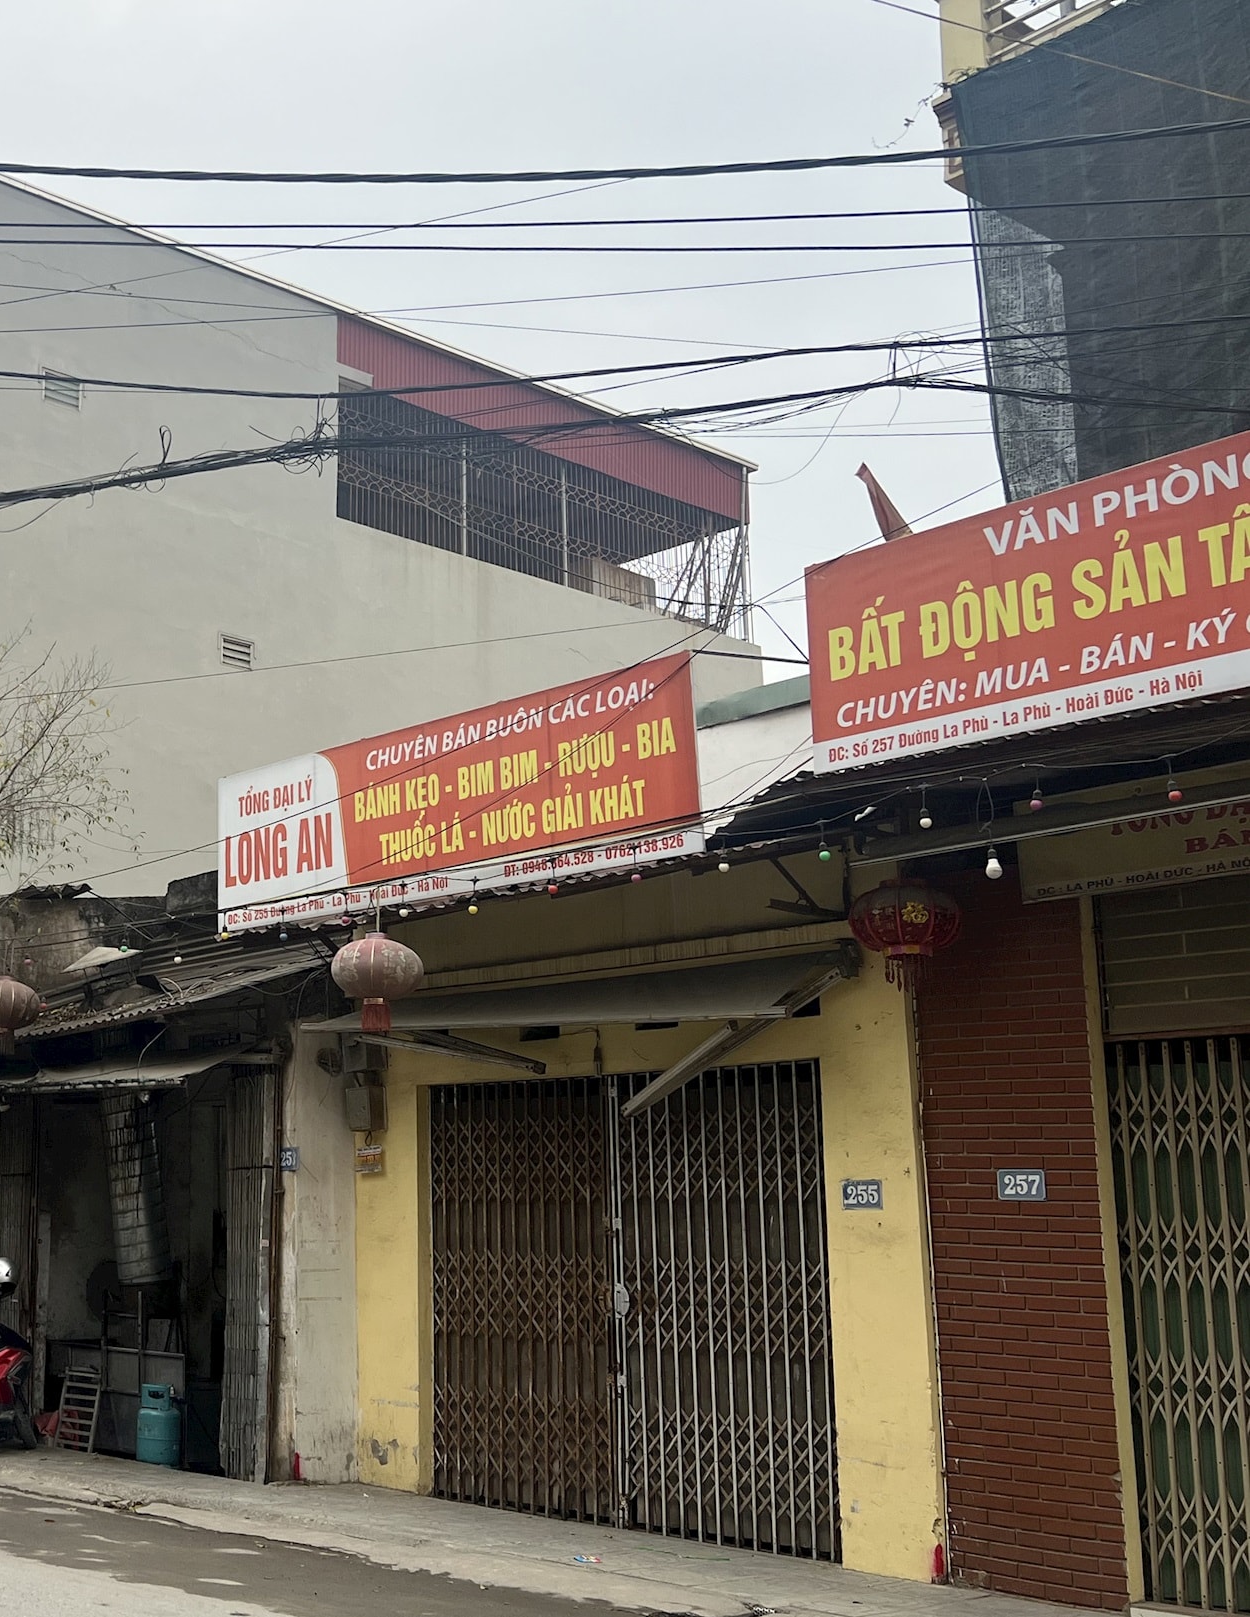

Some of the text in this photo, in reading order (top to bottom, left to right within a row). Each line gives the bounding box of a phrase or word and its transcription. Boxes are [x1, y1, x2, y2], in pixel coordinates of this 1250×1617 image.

[983, 504, 1079, 556] VĂN
[828, 595, 905, 681] BẤT
[919, 573, 1055, 661] ĐỘNG
[1071, 529, 1186, 620] SẢN
[836, 676, 966, 728] CHUYÊN:
[974, 657, 1049, 698] MUA
[1079, 632, 1154, 674] BÁN
[1186, 607, 1236, 651] KÝ
[365, 734, 438, 771] CHUYÊN
[441, 718, 481, 754] BÁN
[485, 706, 543, 742] BUÔN
[547, 693, 590, 726] CÁC
[828, 746, 849, 762] ĐC:
[852, 737, 868, 758] Số
[872, 735, 894, 753] 257
[898, 726, 938, 750] Đường
[943, 721, 958, 739] La
[963, 714, 988, 735] Phù
[1003, 709, 1019, 727] La
[1024, 702, 1050, 724] Phù
[1066, 690, 1099, 713] Hoài
[1104, 685, 1134, 707] Đức
[1149, 677, 1170, 697] Hà
[1175, 669, 1203, 691] Nội
[237, 774, 312, 818] TỔNG ĐẠI LÝ
[353, 782, 402, 823] BÁNH
[404, 773, 440, 814] KẸO
[458, 763, 494, 800] BIM
[500, 749, 539, 789] BIM
[557, 730, 616, 780] RƯỢU
[636, 717, 676, 760] BIA
[224, 812, 333, 888] LONG AN
[379, 808, 437, 866] THUỐC
[440, 811, 464, 855] LÁ
[481, 798, 538, 847] NƯỚC
[541, 782, 584, 835] GIẢI
[590, 776, 646, 825] KHÁT
[605, 834, 684, 860] 0762138.926
[254, 909, 269, 920] 255
[1067, 883, 1083, 893] LA
[845, 1185, 879, 1204] 255
[1003, 1174, 1040, 1195] 257
